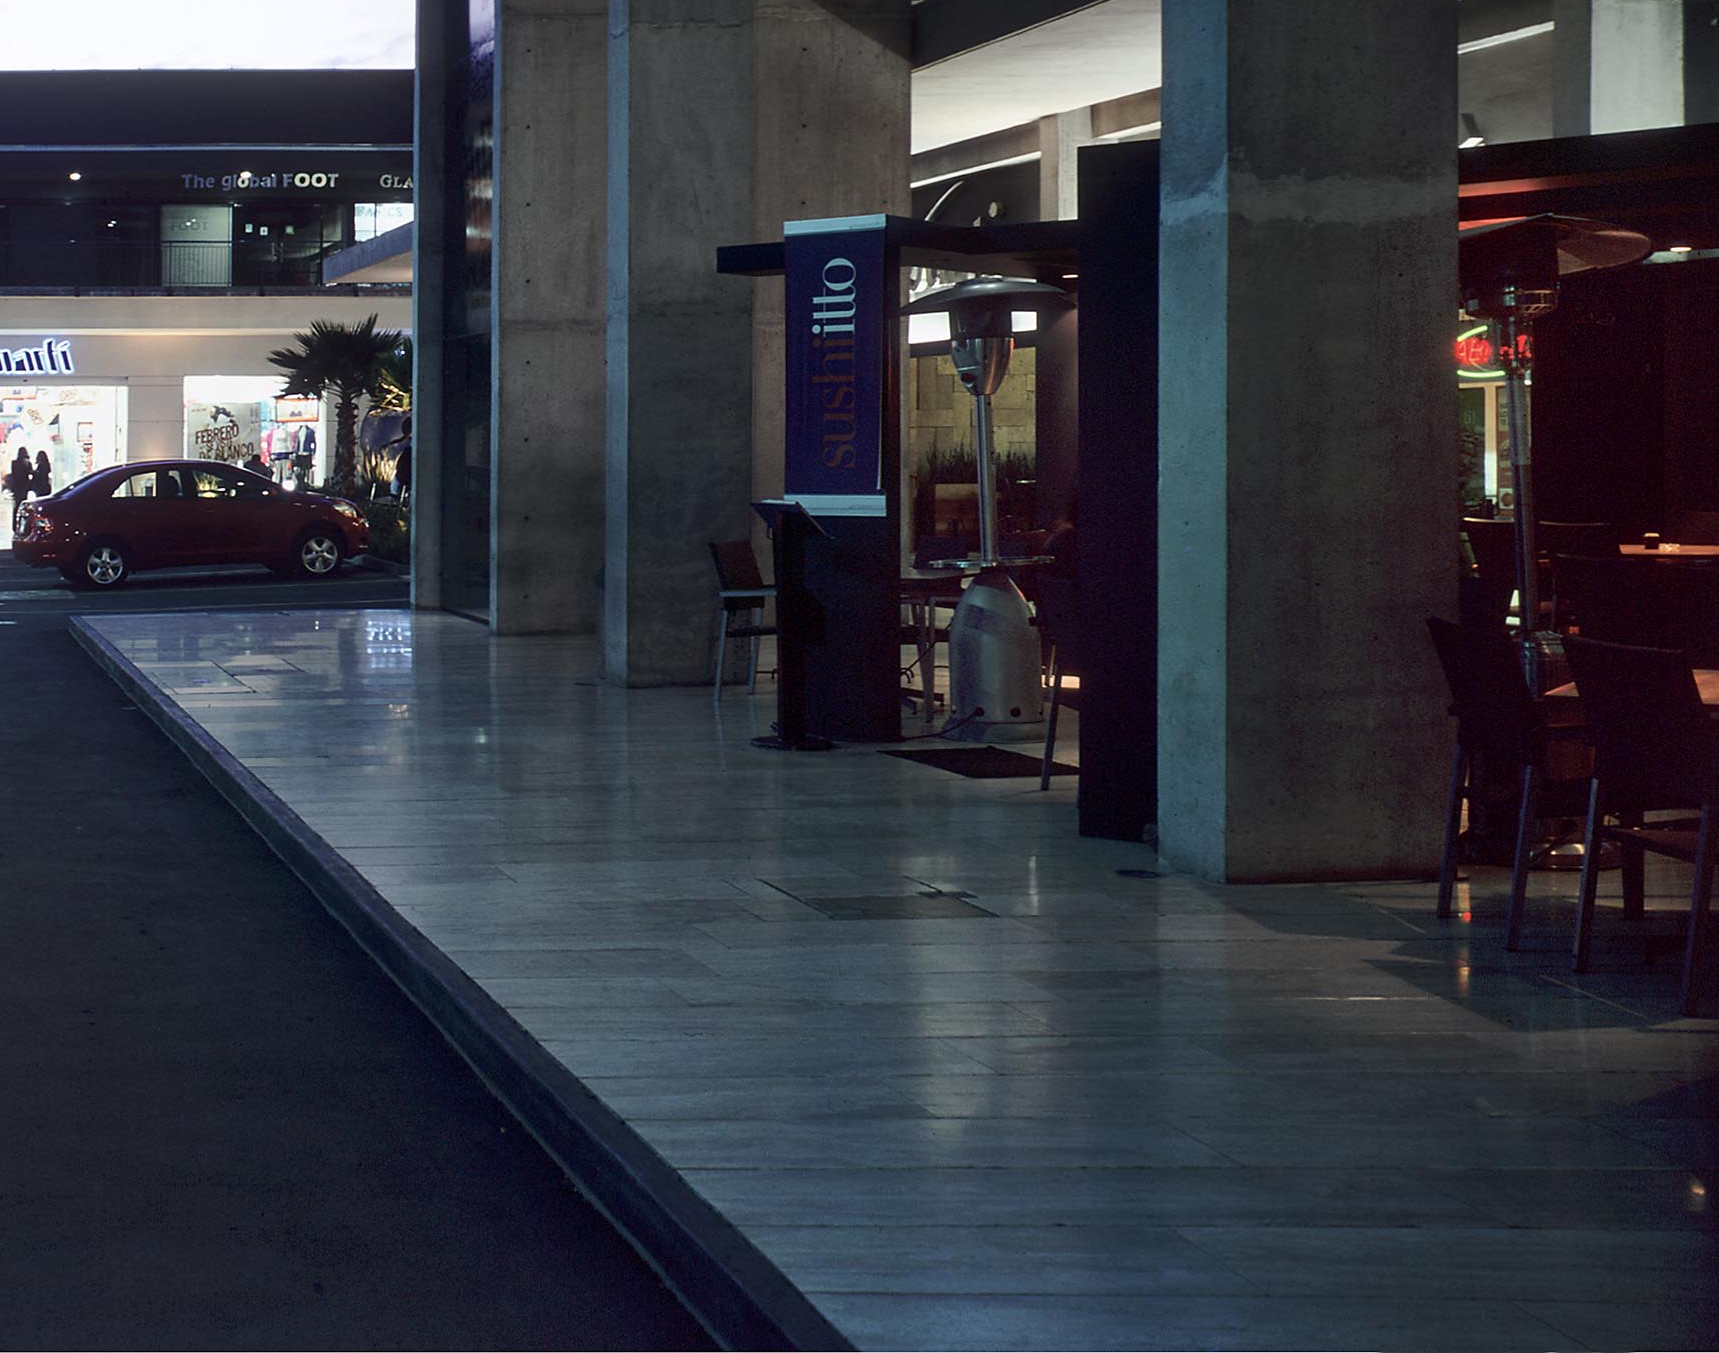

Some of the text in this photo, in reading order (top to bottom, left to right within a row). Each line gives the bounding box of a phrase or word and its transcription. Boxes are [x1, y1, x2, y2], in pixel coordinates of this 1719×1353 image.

[182, 172, 339, 191] The global FOOT
[195, 424, 239, 444] FEBRERO
